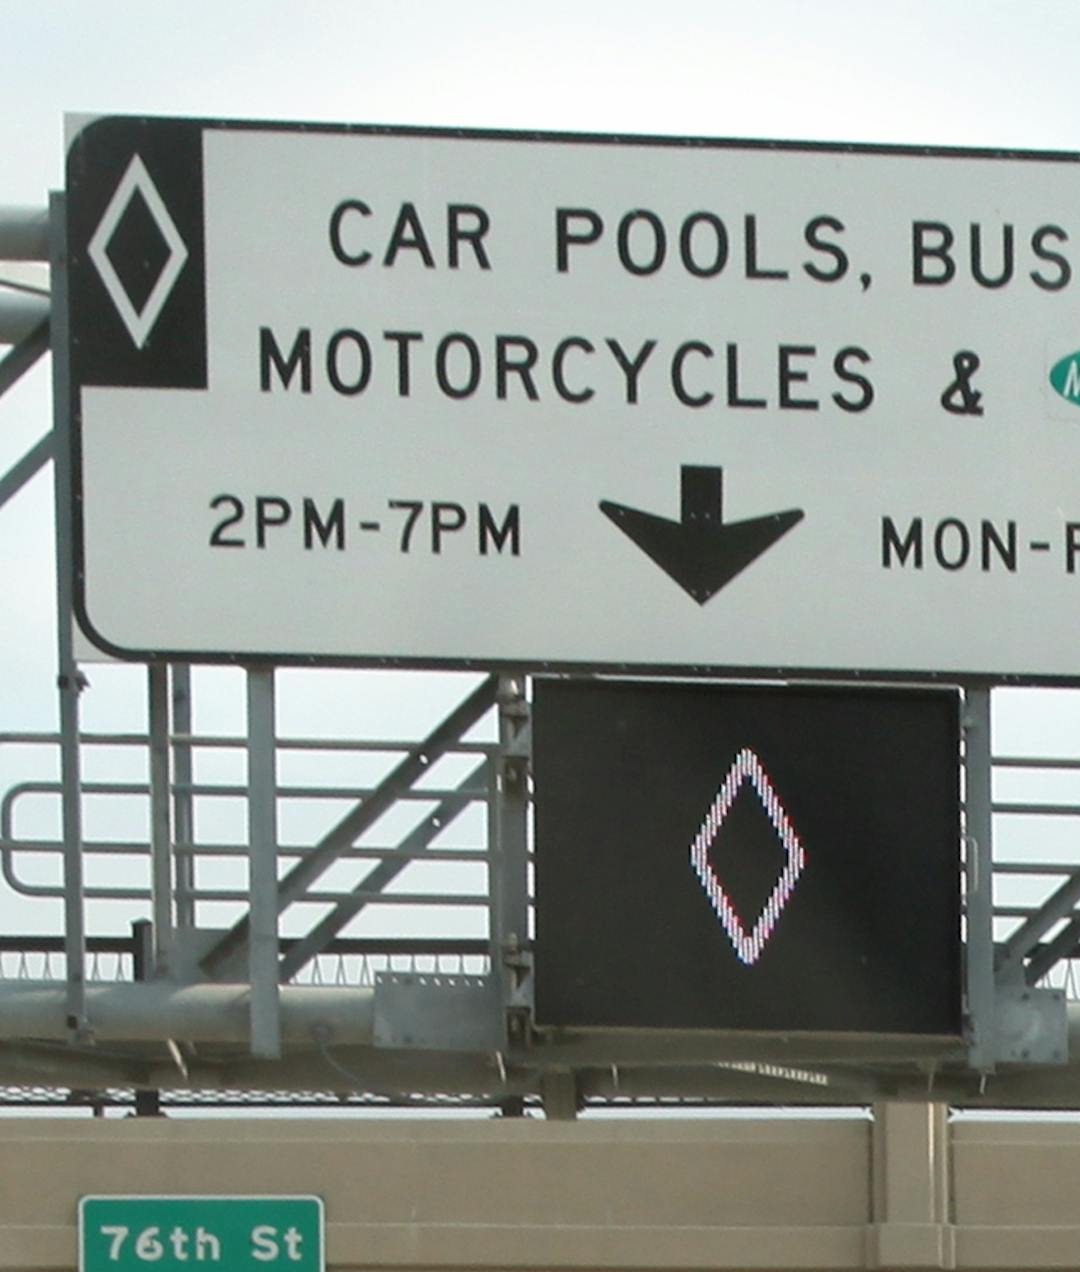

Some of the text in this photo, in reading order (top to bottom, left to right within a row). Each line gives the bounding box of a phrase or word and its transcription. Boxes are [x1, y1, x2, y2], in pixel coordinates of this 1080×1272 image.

[328, 198, 492, 272] CAR
[554, 206, 873, 293] POOLS,
[258, 325, 985, 418] MOTORCYCLES &
[208, 492, 521, 558] 2PM-7PM
[100, 1225, 303, 1262] 76th St
